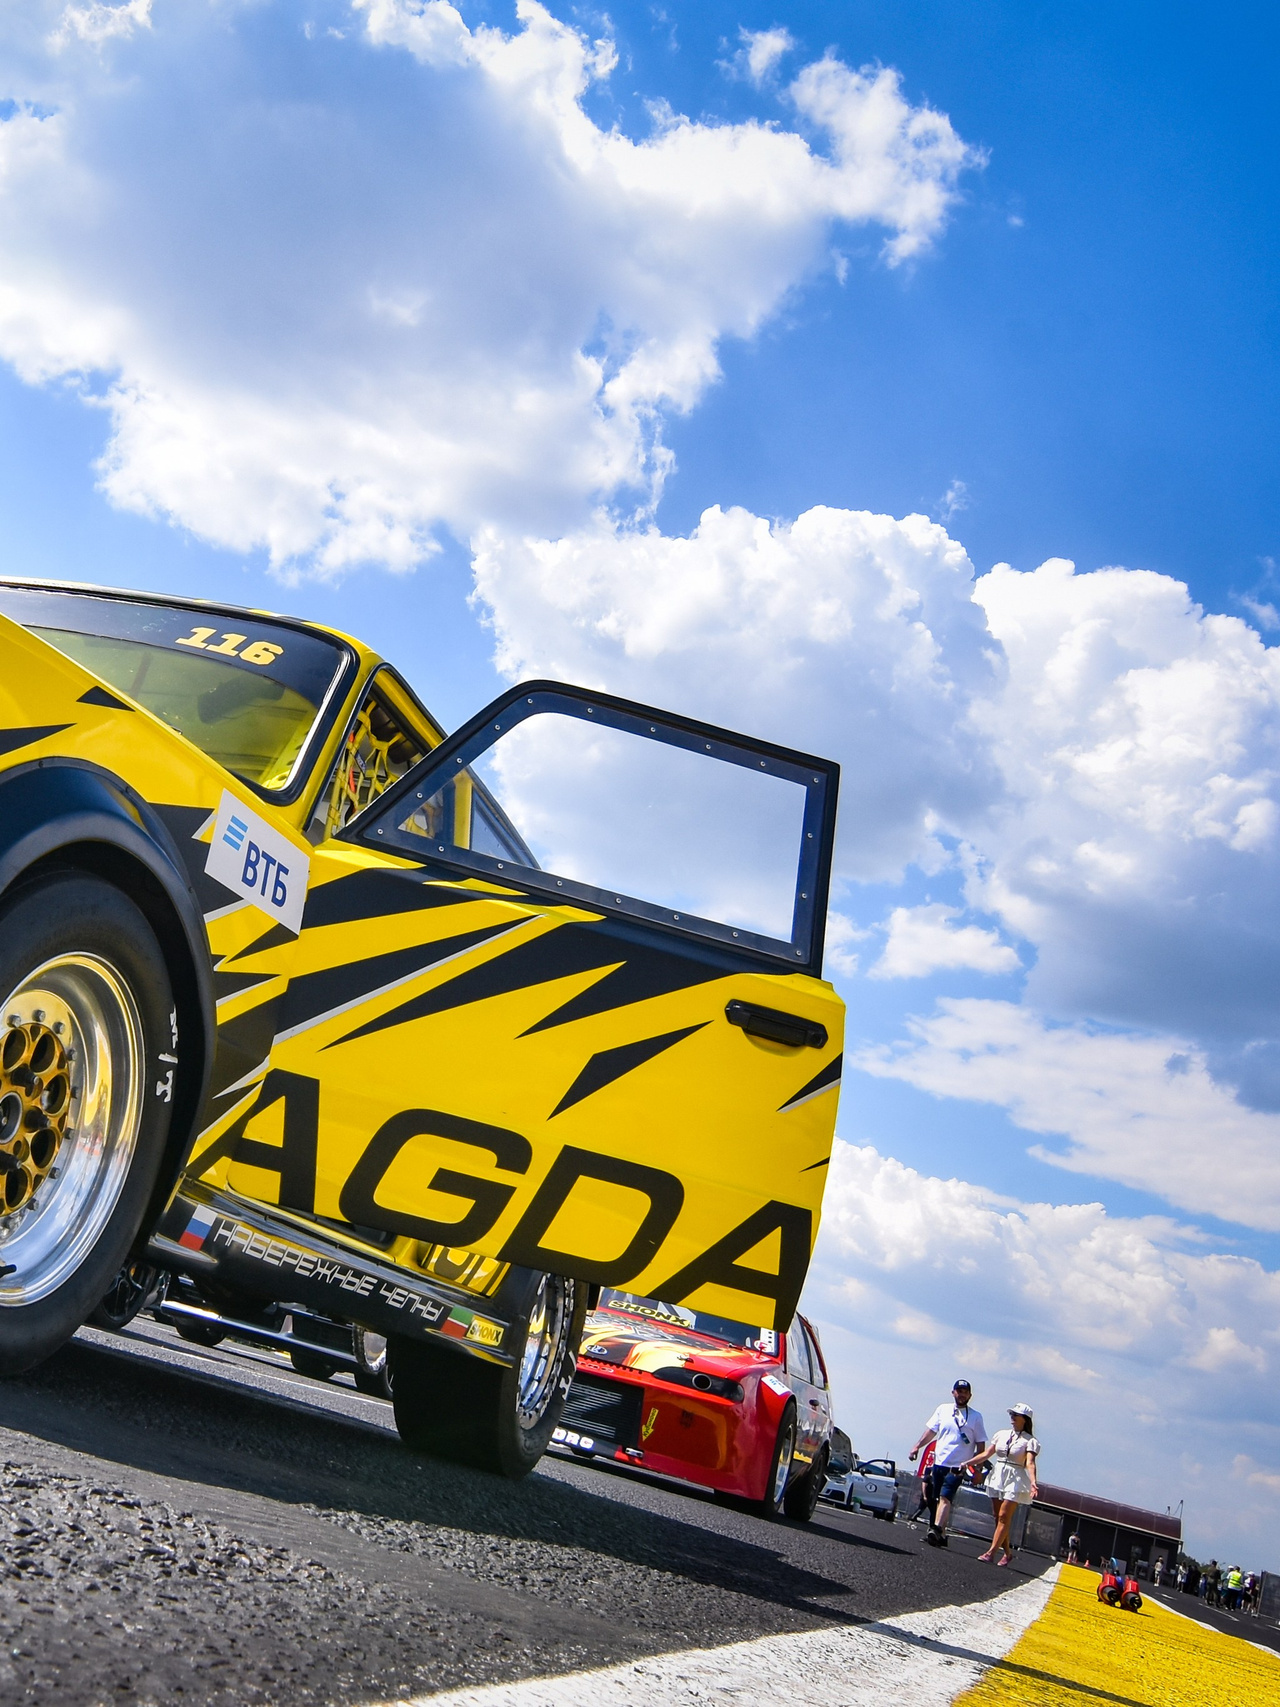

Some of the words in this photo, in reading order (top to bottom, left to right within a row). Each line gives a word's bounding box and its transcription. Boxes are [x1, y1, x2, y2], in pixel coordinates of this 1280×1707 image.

[175, 627, 284, 666] 116
[241, 840, 289, 908] ВТБ
[186, 1068, 813, 1334] AGDA
[214, 1219, 378, 1297] НАБЕРЕЖНЫЕ
[379, 1282, 445, 1322] ЧЕЛНЫ
[470, 1323, 502, 1343] SHONX
[609, 1300, 691, 1327] SHONX
